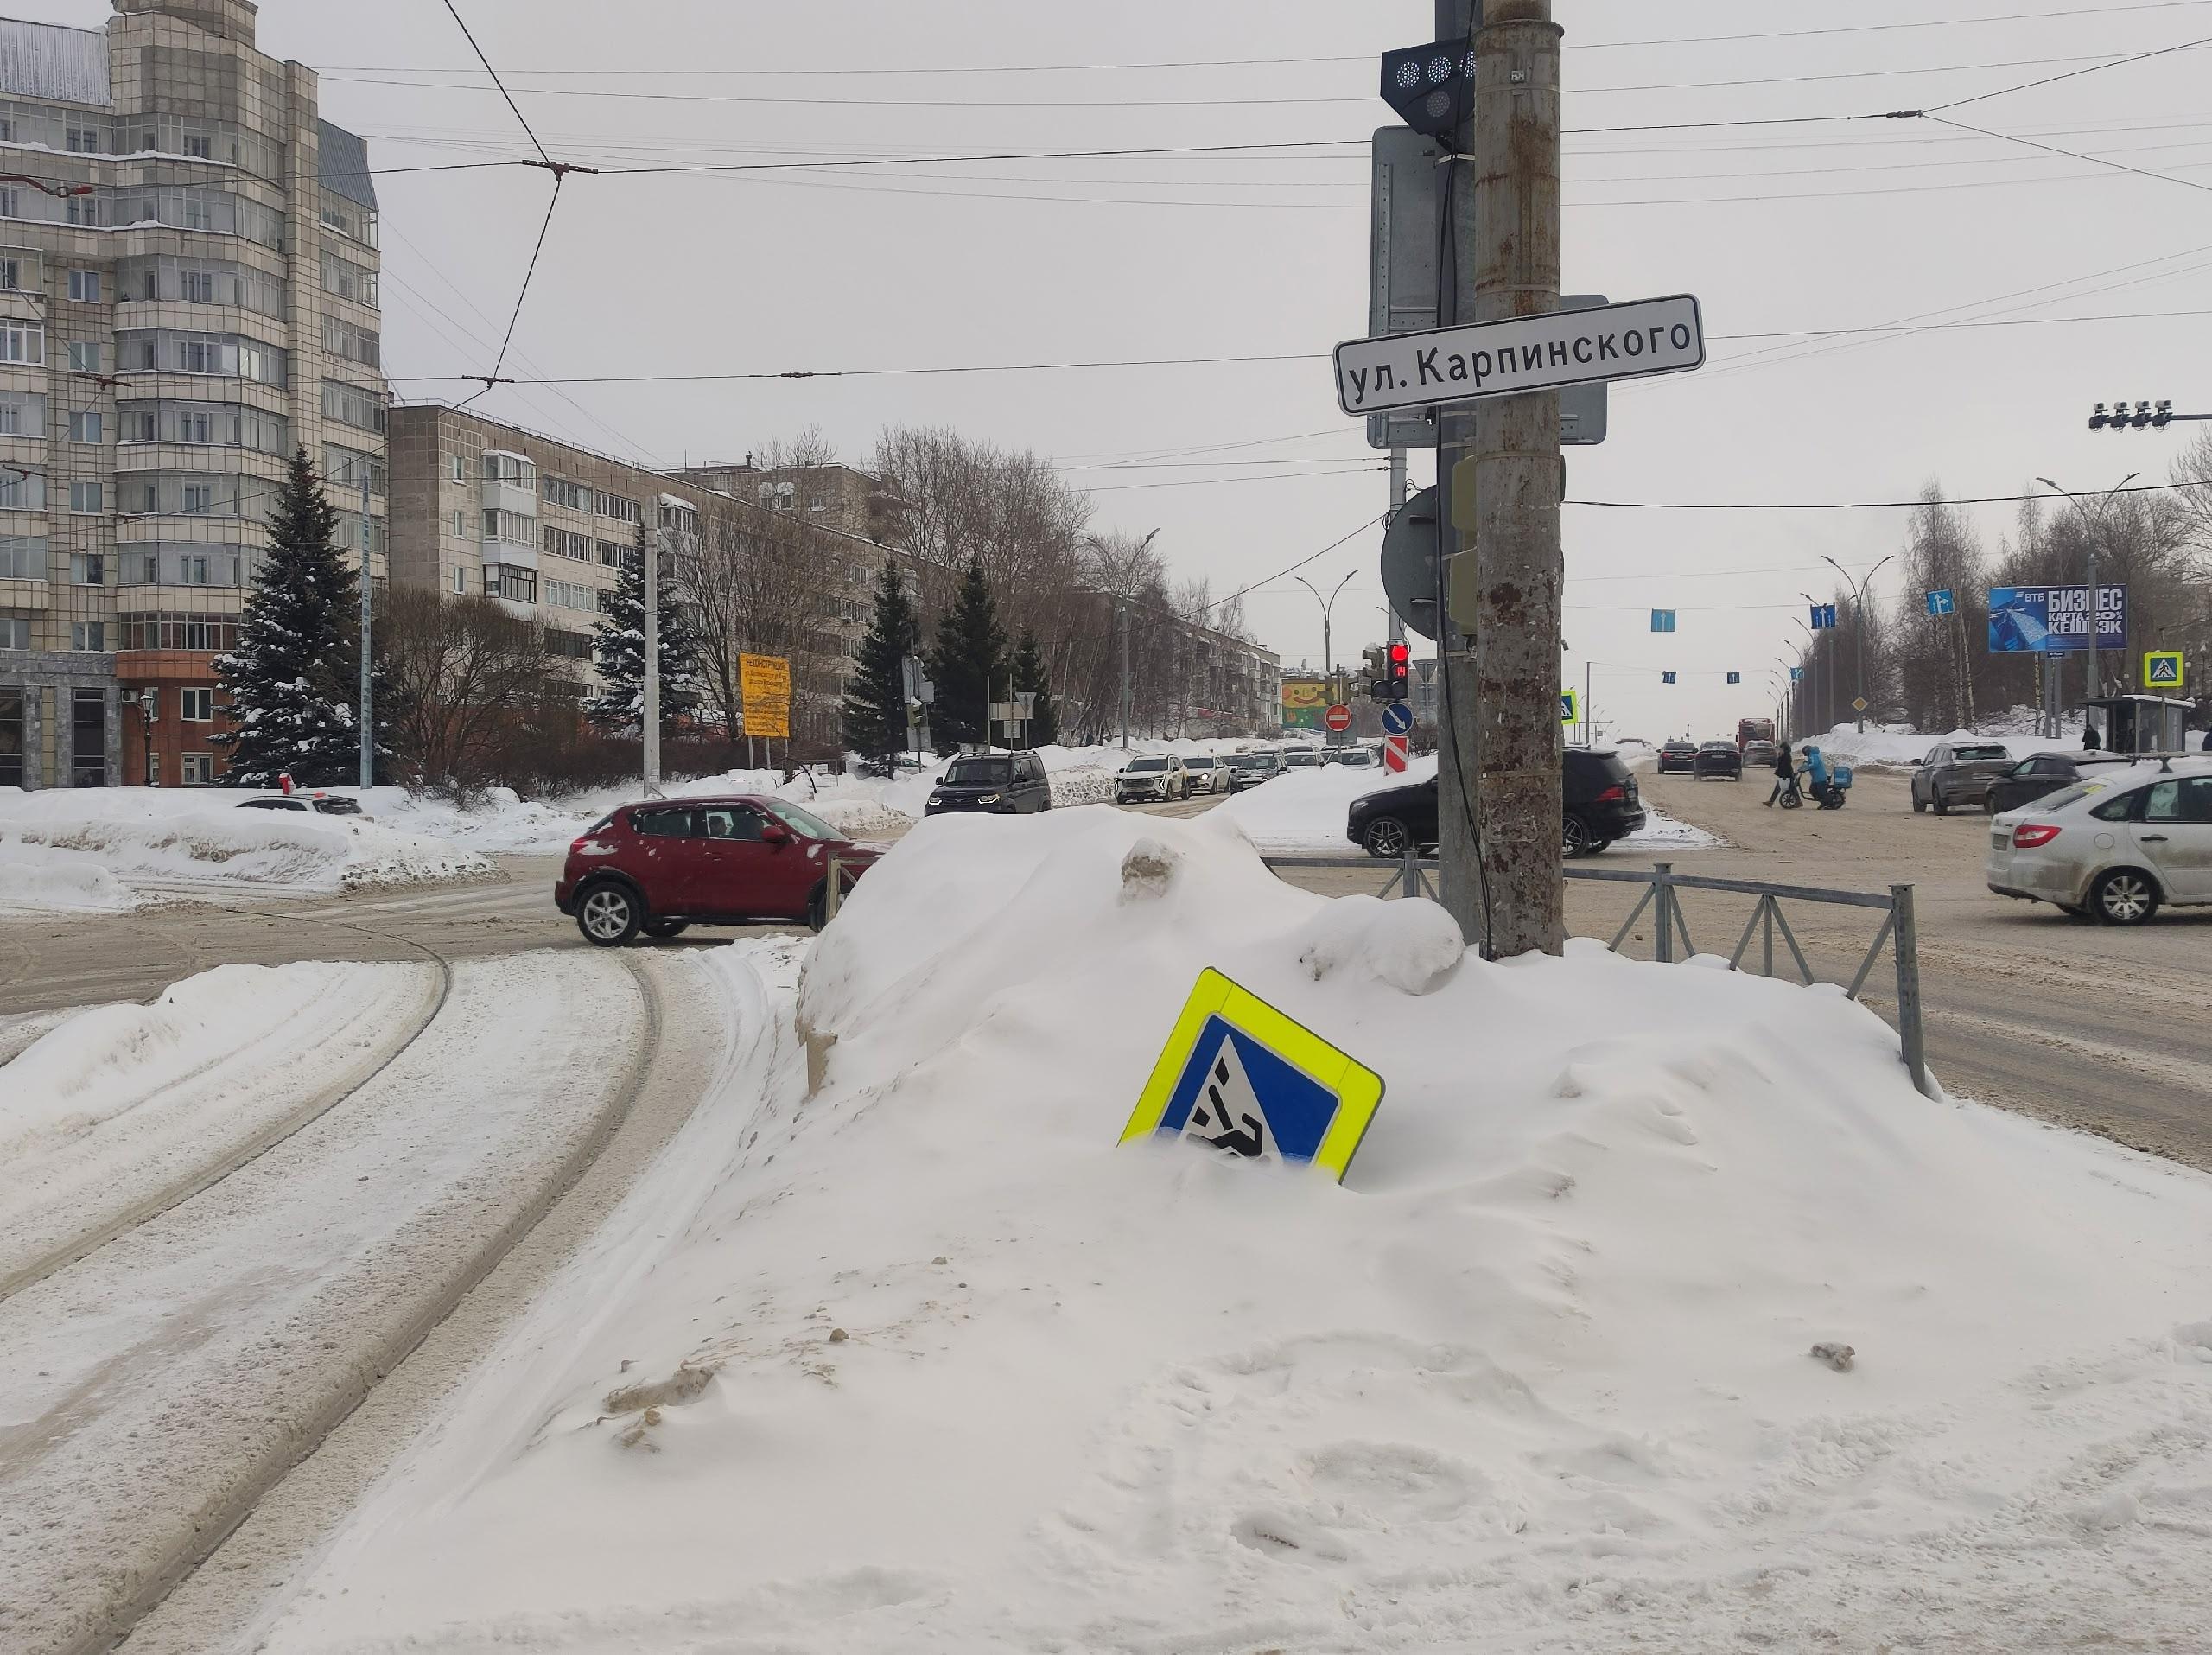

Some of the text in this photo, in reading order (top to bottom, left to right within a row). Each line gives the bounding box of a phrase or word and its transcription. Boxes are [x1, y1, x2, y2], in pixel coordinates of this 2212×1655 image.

[1349, 323, 1691, 404] ул. Карпинского
[2024, 593, 2045, 602] ВТБ
[2048, 611, 2084, 621] КАРТА
[1397, 666, 1406, 677] 14
